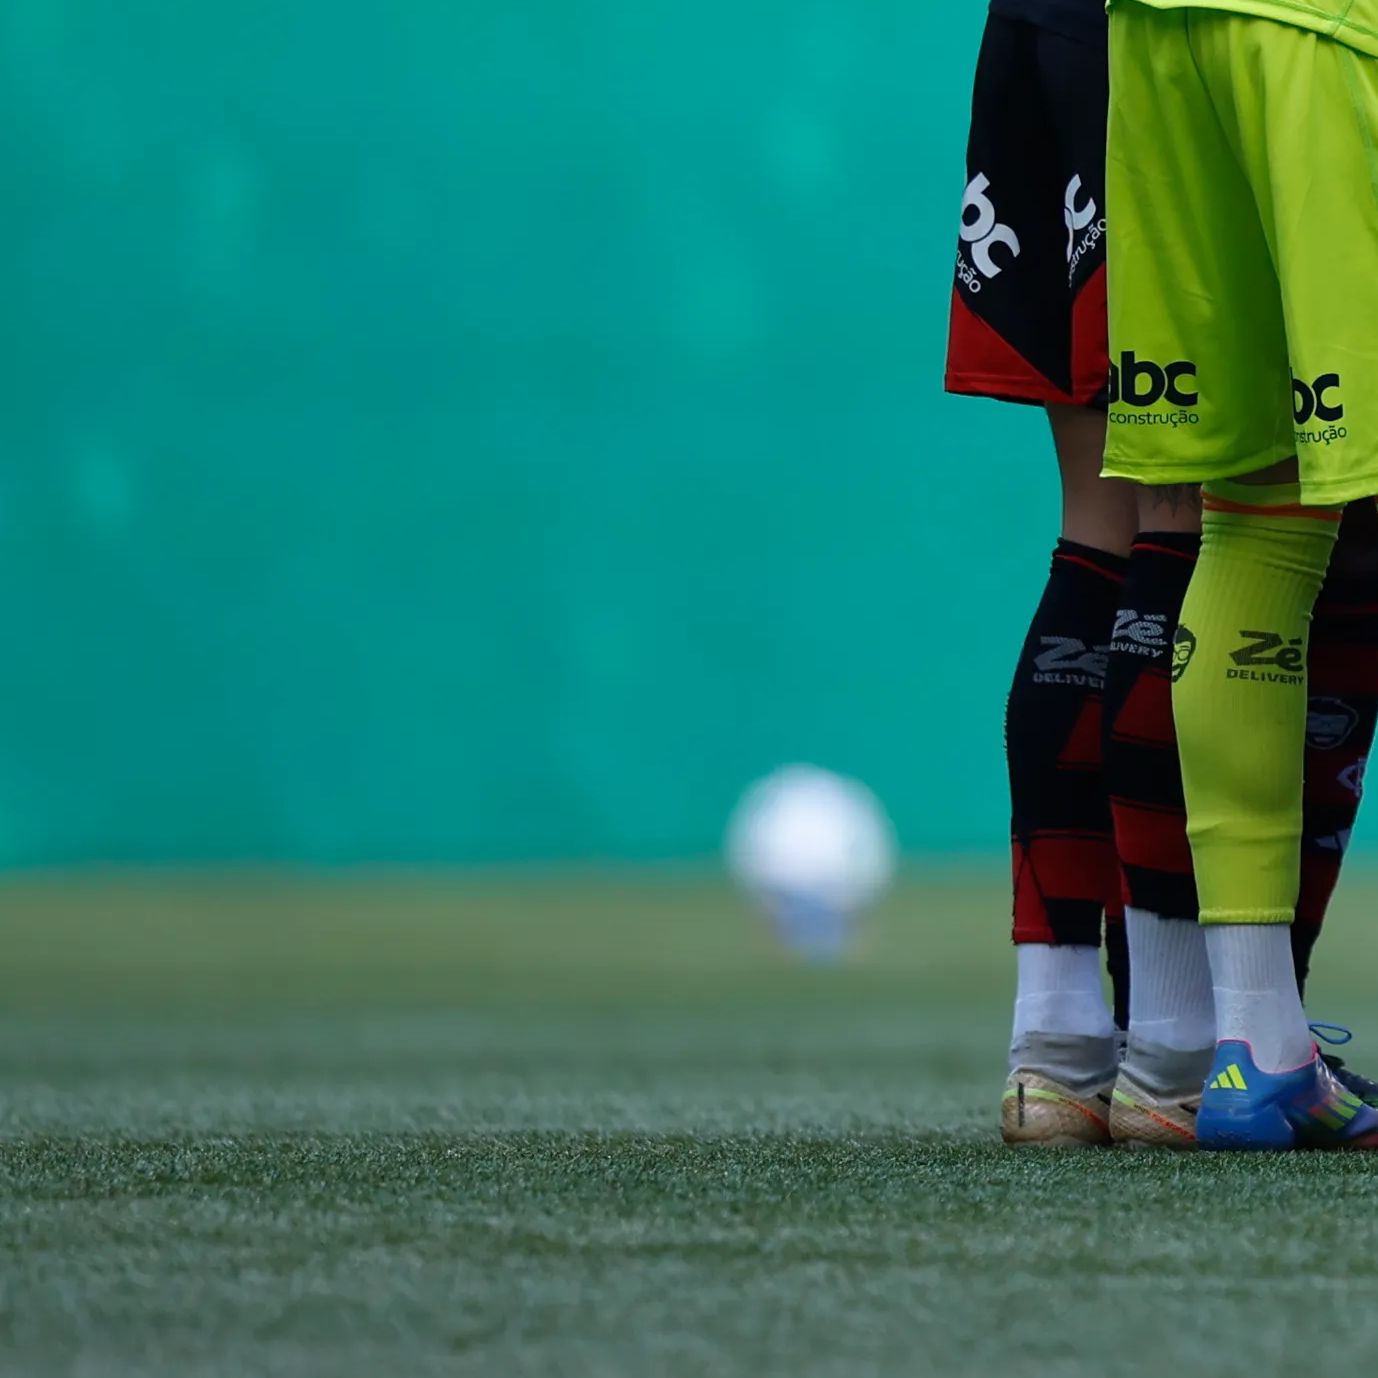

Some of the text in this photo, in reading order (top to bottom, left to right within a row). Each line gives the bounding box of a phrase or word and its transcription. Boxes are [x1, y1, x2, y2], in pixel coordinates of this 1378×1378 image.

[958, 171, 1021, 279] bc
[1290, 366, 1344, 425] bc
[1109, 409, 1200, 428] construção
[1226, 668, 1304, 686] DELIVERY
